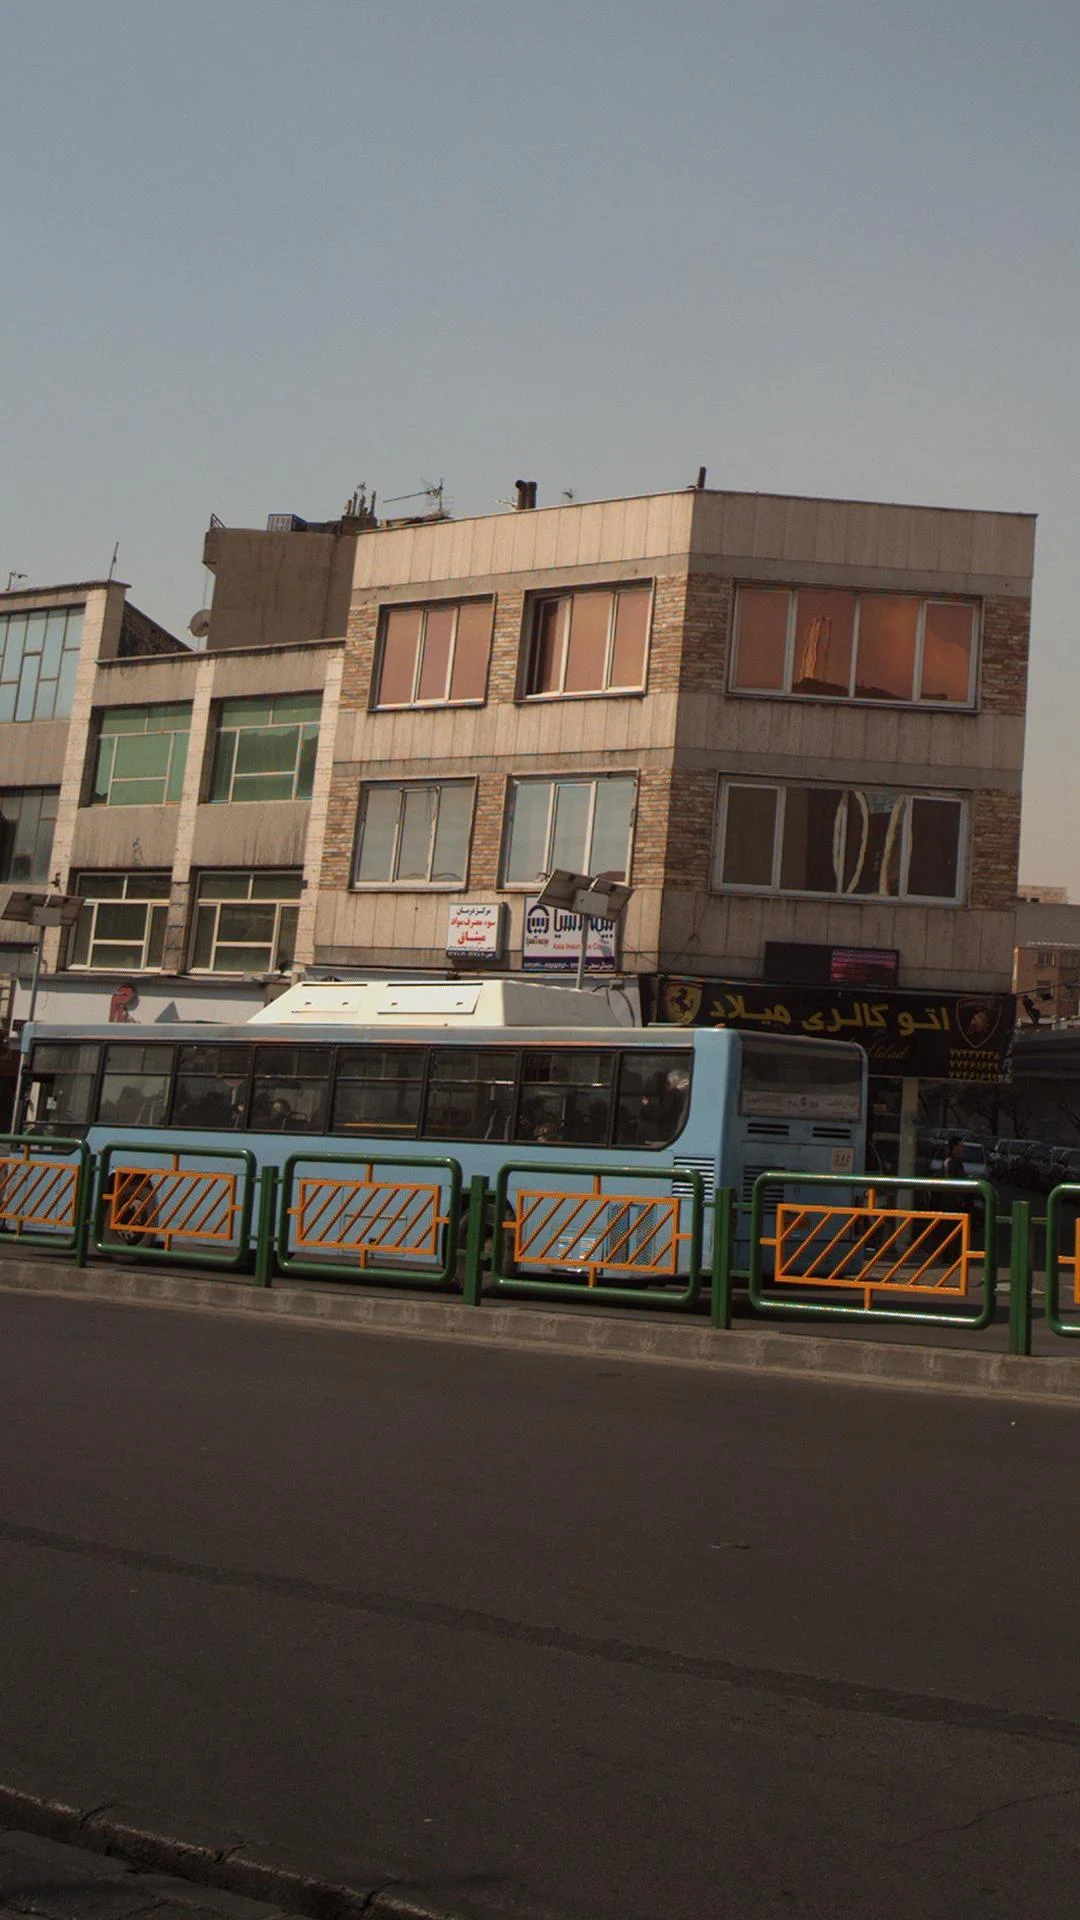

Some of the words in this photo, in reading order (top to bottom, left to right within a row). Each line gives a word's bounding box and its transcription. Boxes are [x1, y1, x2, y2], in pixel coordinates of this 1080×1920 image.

[475, 908, 491, 916] مرکز
[709, 993, 792, 1025] میلاد
[897, 1006, 951, 1036] اتو
